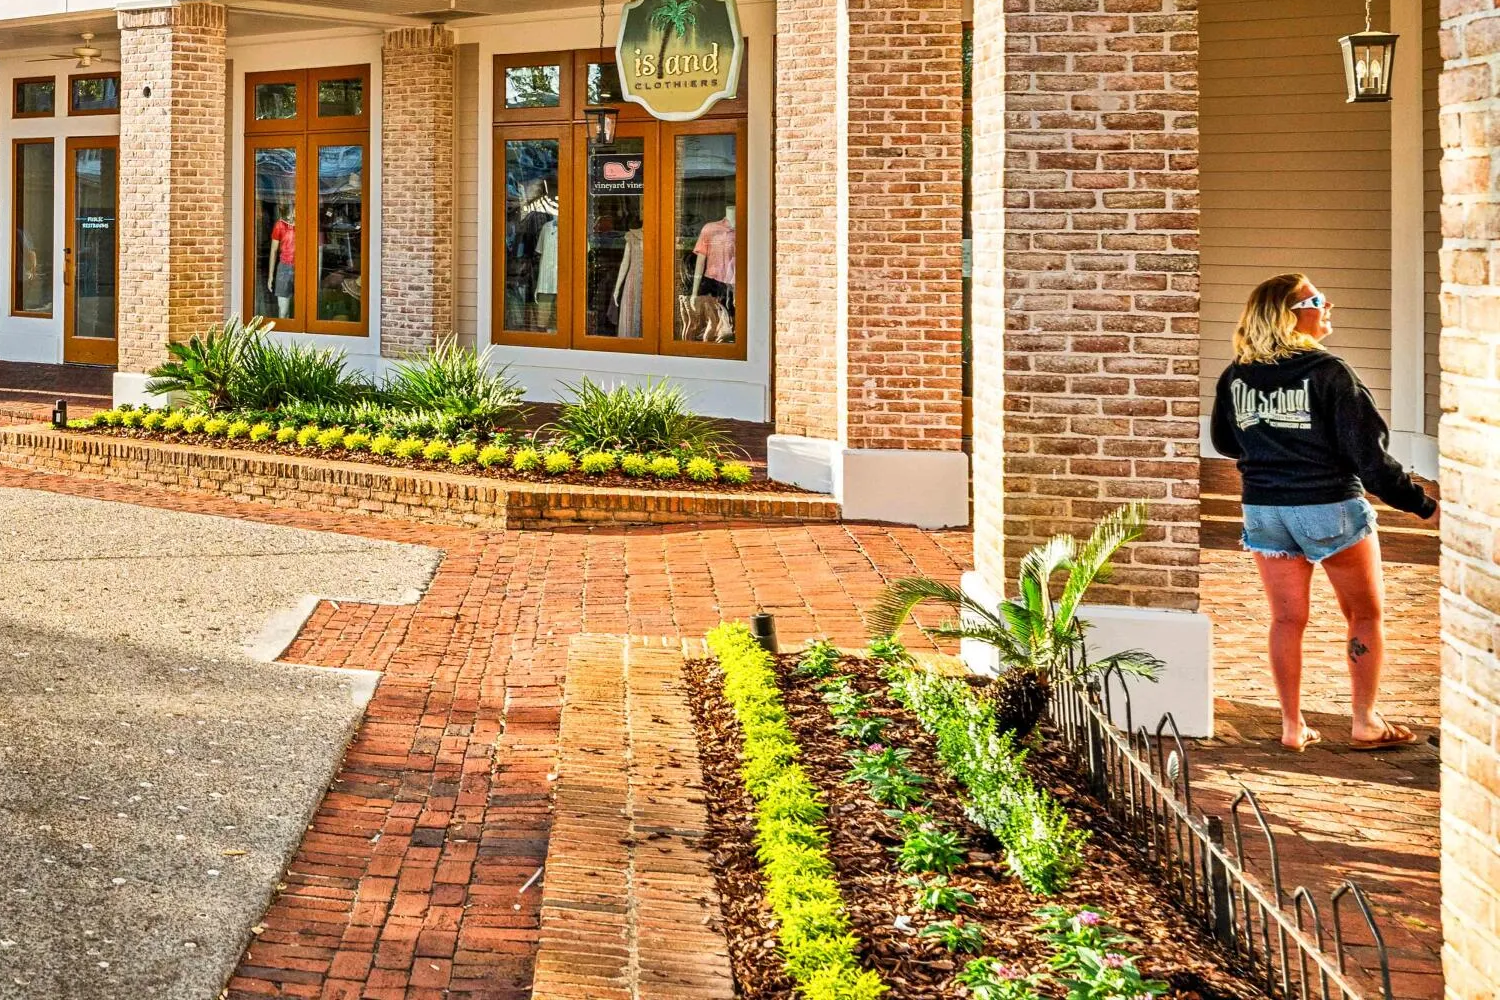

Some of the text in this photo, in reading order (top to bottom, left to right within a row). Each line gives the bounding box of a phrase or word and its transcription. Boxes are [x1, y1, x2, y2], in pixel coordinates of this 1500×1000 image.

[634, 41, 719, 78] island
[634, 78, 719, 90] CLOTHIERS
[594, 180, 625, 192] vineyard
